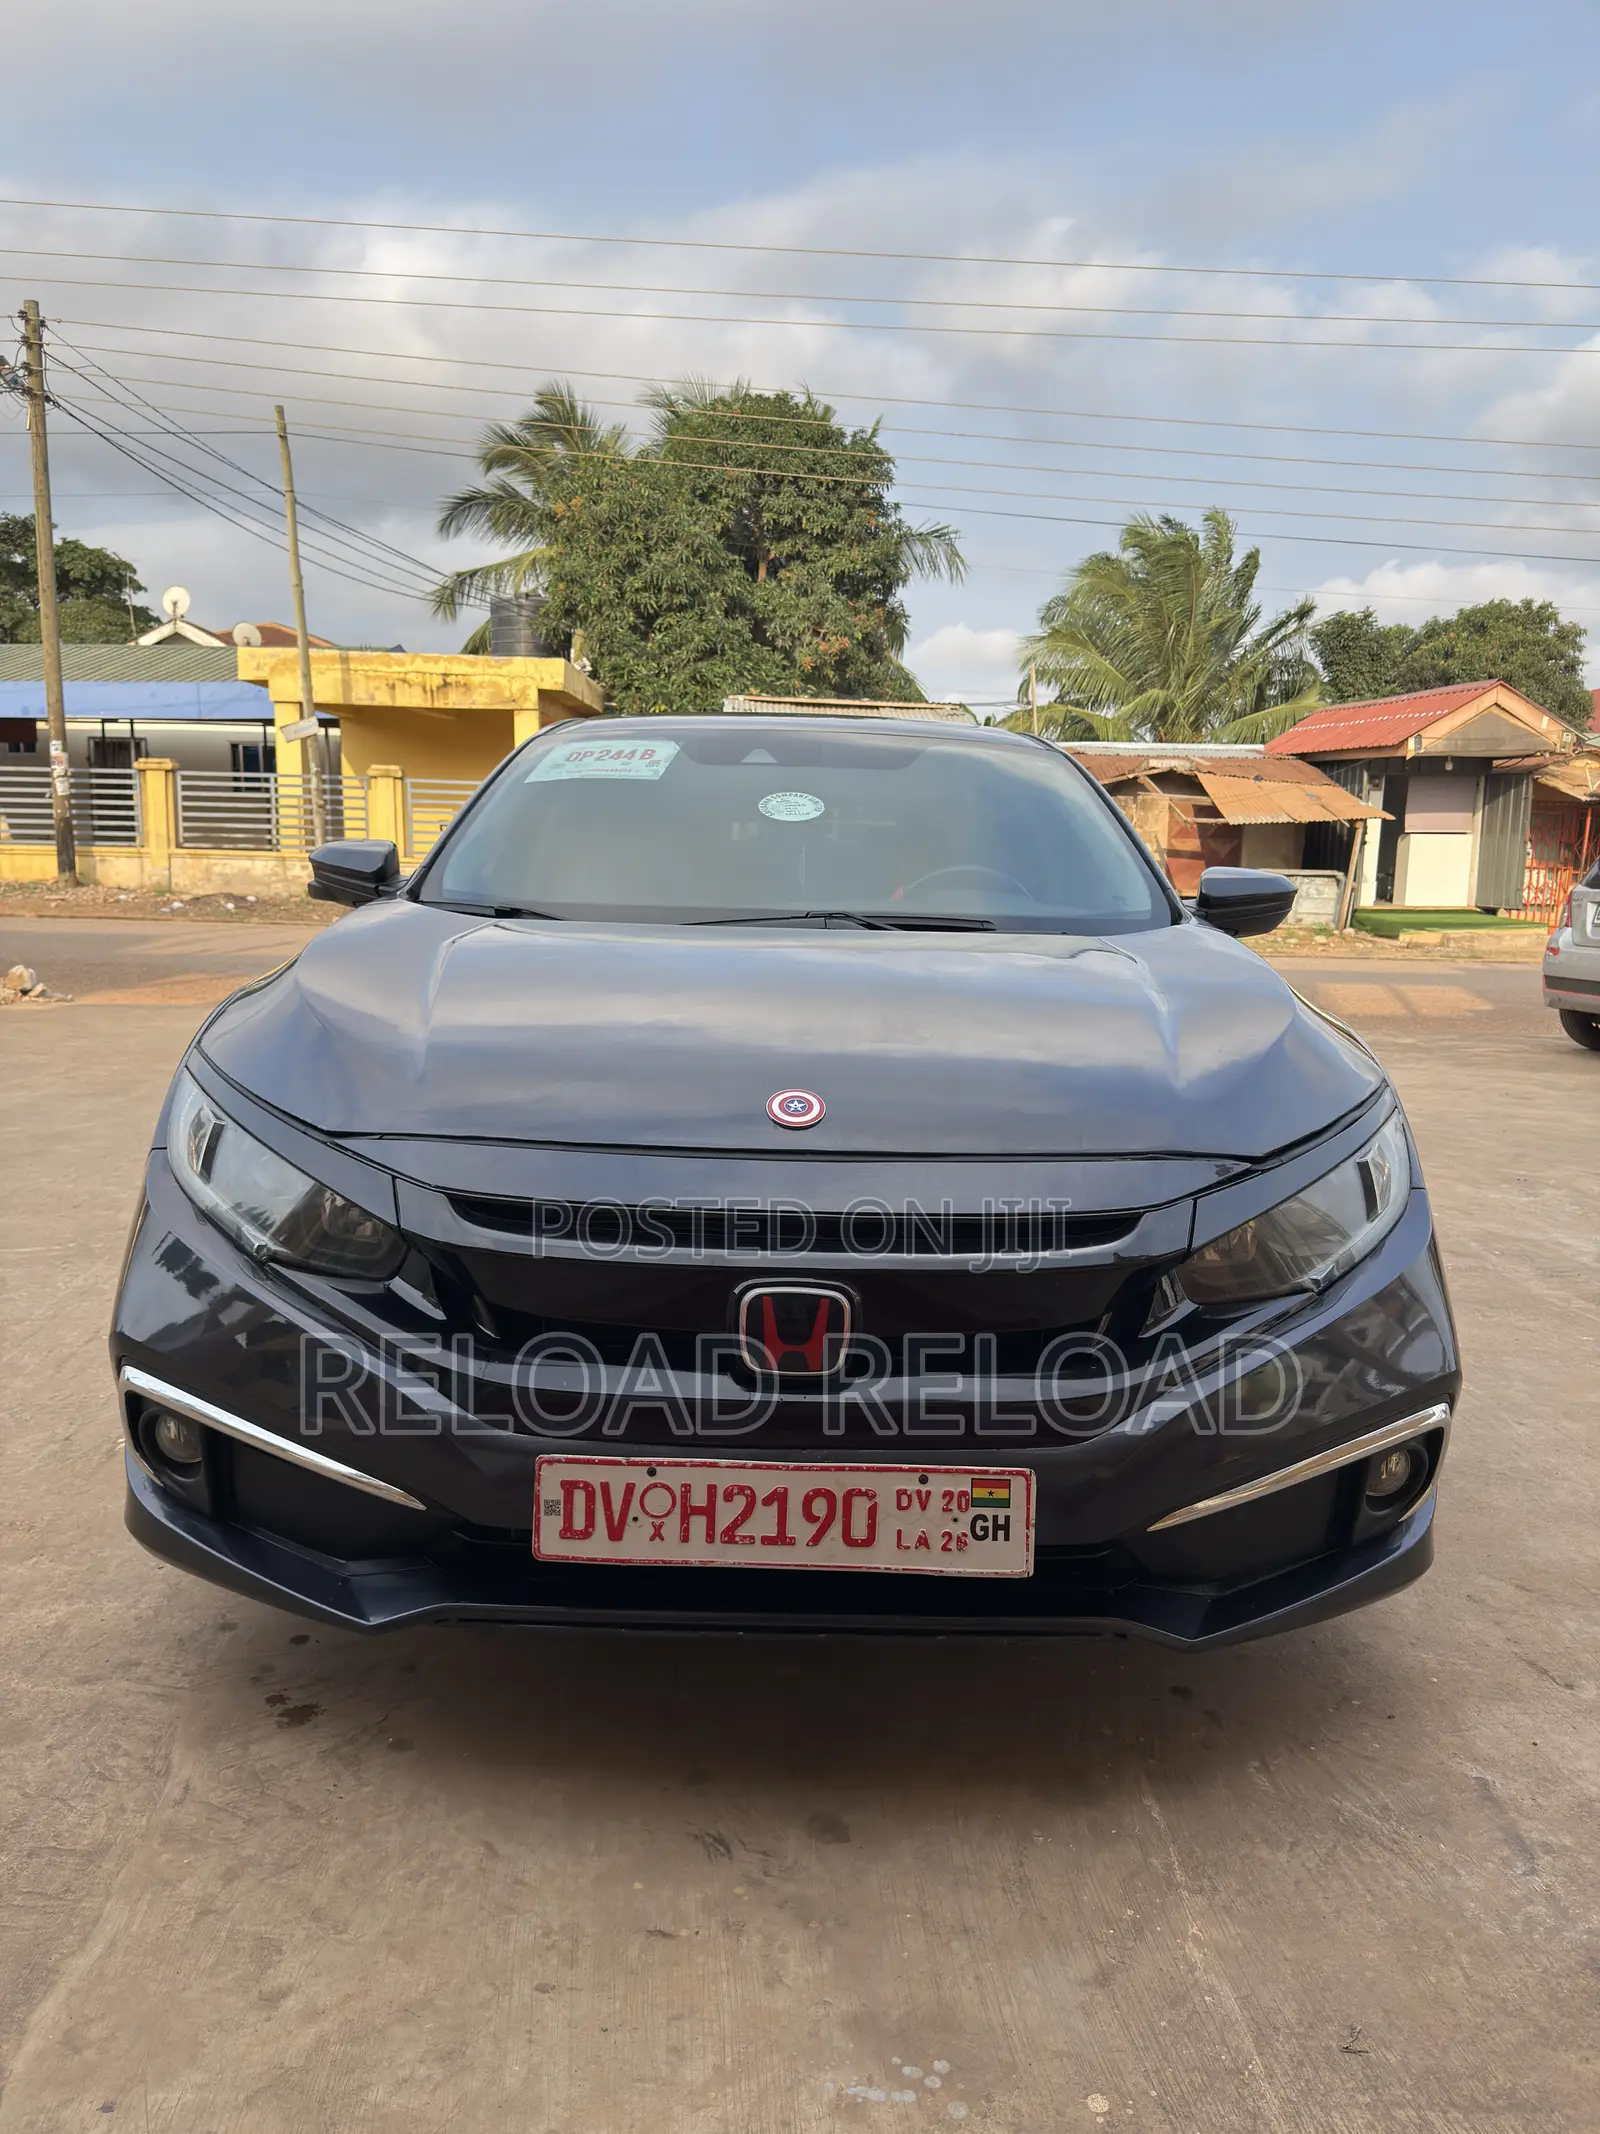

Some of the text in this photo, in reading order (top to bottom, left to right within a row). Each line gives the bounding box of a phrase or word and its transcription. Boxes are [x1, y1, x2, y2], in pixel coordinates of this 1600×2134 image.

[565, 749, 656, 763] DP 244 B
[896, 1488, 970, 1512] DV 20
[896, 1528, 931, 1550] LA
[970, 1513, 1011, 1542] GH
